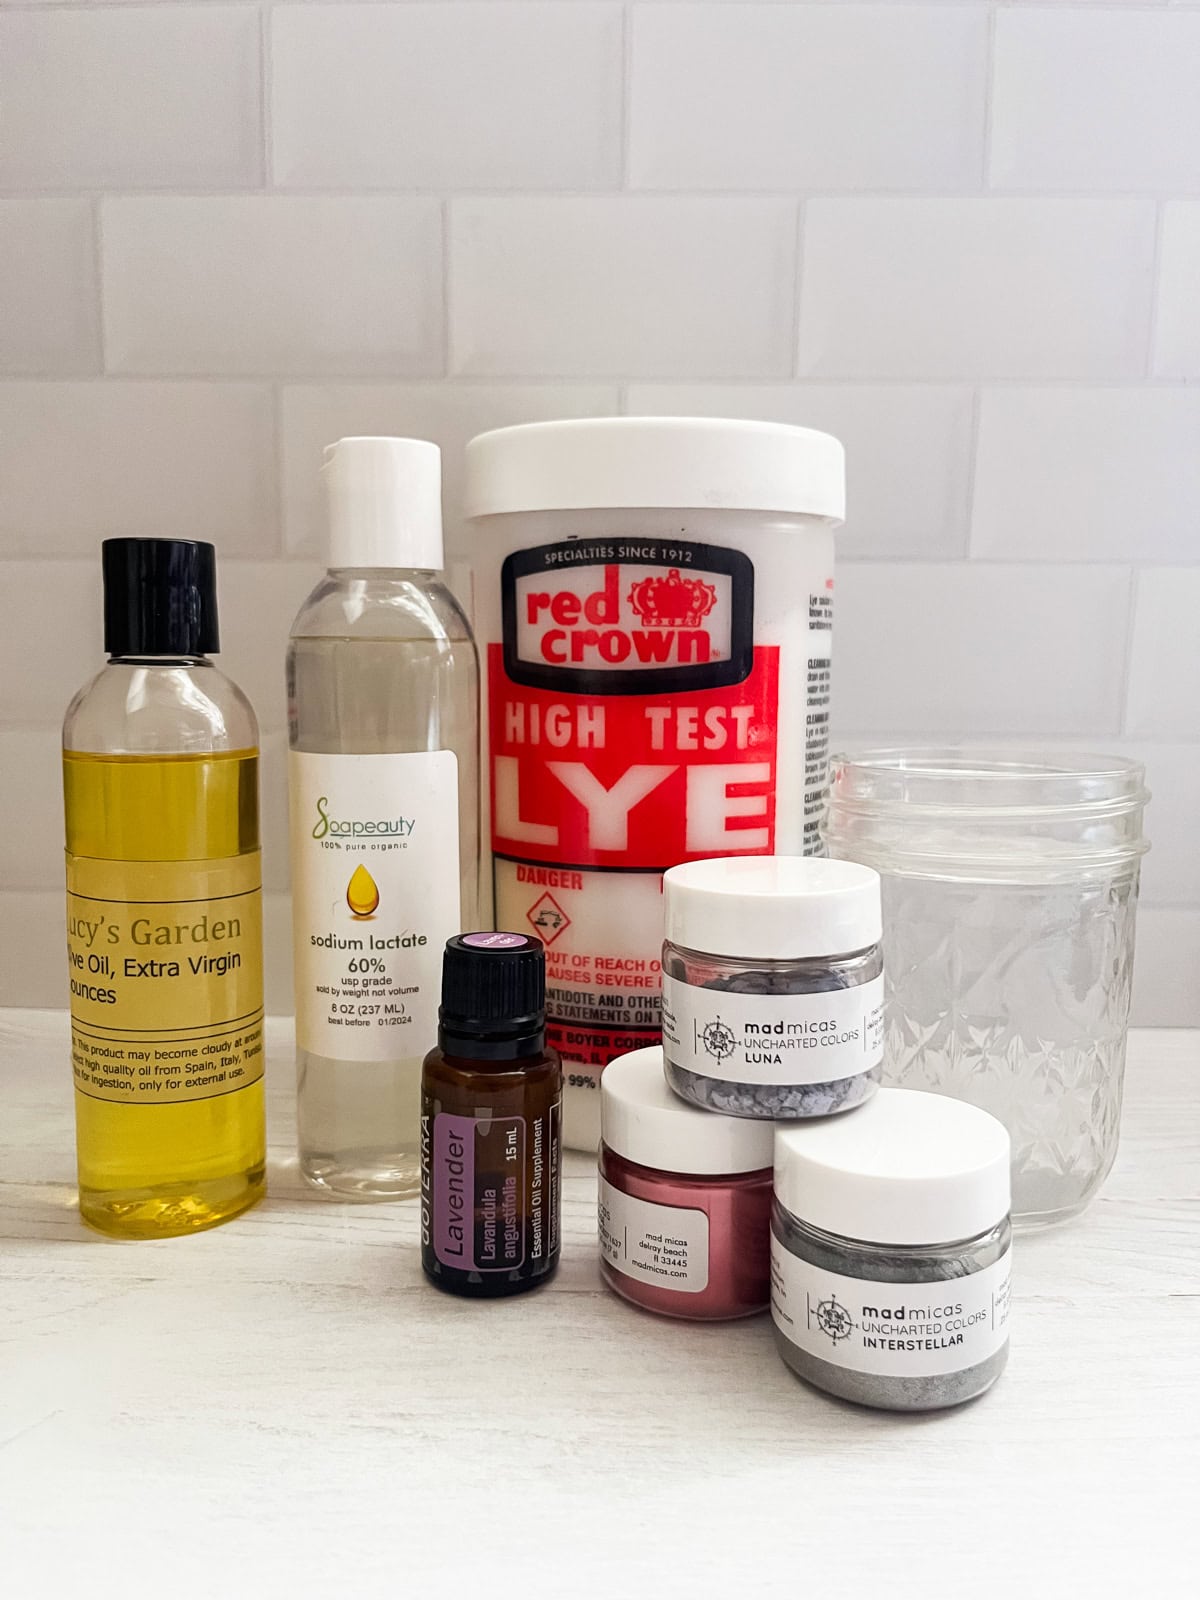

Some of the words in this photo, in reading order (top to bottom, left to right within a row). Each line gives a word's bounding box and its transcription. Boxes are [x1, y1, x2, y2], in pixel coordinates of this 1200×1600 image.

[544, 546, 614, 565] SPECIALTIES
[618, 546, 656, 559] SINCE
[660, 548, 692, 562] 1912
[527, 564, 620, 625] red
[541, 629, 711, 663] crown
[505, 702, 606, 749] HIGH
[645, 704, 755, 750] TEST
[495, 755, 771, 853] LYE
[312, 797, 415, 839] Soapeauty
[320, 841, 342, 850] 100%
[346, 843, 366, 851] pure
[371, 842, 408, 851] organic
[516, 864, 583, 890] DANGER
[68, 916, 120, 948] ucy's
[131, 916, 241, 946] Garden
[311, 933, 363, 950] sodium
[370, 932, 427, 950] lactate
[88, 955, 116, 979] Oil,
[124, 959, 180, 977] Extra
[188, 952, 241, 976] Virgin
[348, 958, 386, 974] 60%
[545, 951, 568, 965] OUT
[571, 954, 590, 967] OF
[595, 957, 645, 972] REACH
[341, 977, 360, 988] usp
[362, 976, 392, 988] grade
[546, 967, 591, 984] AUSES
[595, 973, 656, 988] SEVERE
[70, 978, 117, 1004] ounces
[316, 985, 330, 993] sold
[331, 987, 340, 997] by
[342, 987, 369, 998] weight
[372, 988, 386, 996] not
[388, 985, 419, 996] volume
[598, 994, 623, 1008] AND
[331, 1004, 337, 1013] 8
[340, 1005, 355, 1015] OZ
[358, 1005, 381, 1016] (237
[384, 1003, 405, 1015] ML)
[556, 1003, 631, 1023] STATEMENTS
[635, 1009, 653, 1023] ON
[328, 1016, 343, 1025] best
[345, 1017, 370, 1027] before
[378, 1016, 412, 1026] 01/2024
[77, 1039, 90, 1052] This
[91, 1046, 124, 1060] product
[128, 1052, 150, 1062] may
[155, 1048, 197, 1060] become
[201, 1038, 232, 1055] cloudy
[234, 1034, 243, 1047] at
[567, 1032, 610, 1047] BOYER
[744, 1038, 818, 1049] UNCHARTED
[820, 1029, 860, 1046] COLORS
[84, 1057, 100, 1071] high
[103, 1064, 135, 1077] quality
[138, 1065, 151, 1076] oil
[155, 1065, 181, 1076] from
[185, 1060, 217, 1074] Spain,
[220, 1054, 241, 1068] Italy,
[745, 1053, 782, 1064] LUNA
[91, 1073, 135, 1091] ingestion,
[139, 1079, 162, 1092] only
[165, 1079, 181, 1090] for
[185, 1073, 227, 1088] external
[228, 1068, 245, 1080] use.
[569, 1074, 596, 1089] 99%
[506, 1127, 517, 1144] mL
[506, 1146, 517, 1161] 15
[532, 1117, 544, 1188] Supplement
[444, 1130, 465, 1257] Lavender
[532, 1190, 541, 1206] Oil
[481, 1188, 496, 1260] Lavandula
[503, 1176, 518, 1259] angustifolia
[531, 1207, 542, 1259] Essential
[645, 1232, 663, 1243] mad
[664, 1237, 688, 1246] micas
[639, 1241, 661, 1254] delray
[663, 1246, 688, 1257] beach
[631, 1259, 688, 1278] madmicas.com
[661, 1257, 688, 1268] 33445
[861, 1320, 942, 1335] UNCHARTED
[945, 1310, 987, 1332] COLORS
[864, 1334, 963, 1351] INTERSTELLAR
